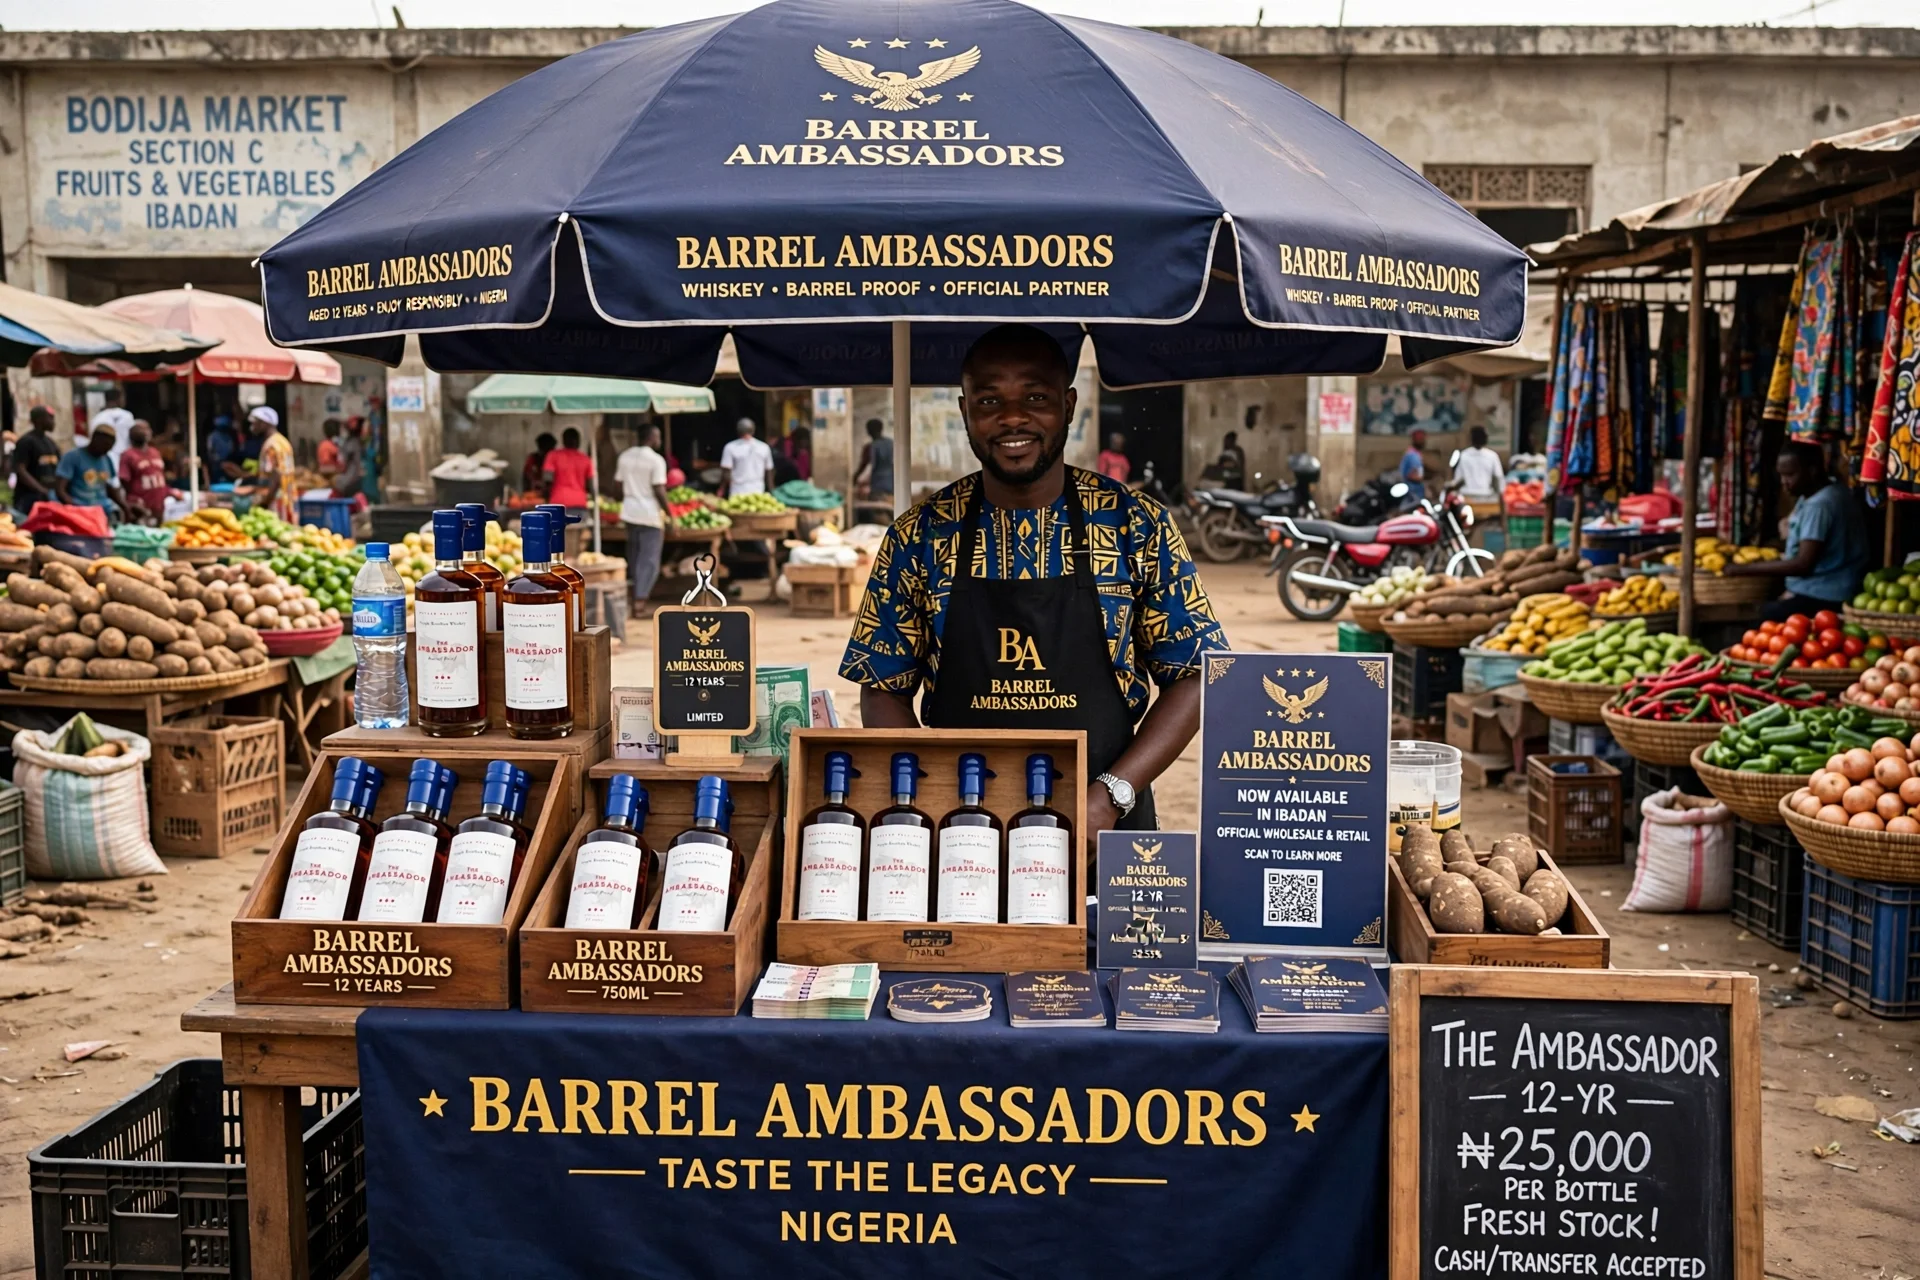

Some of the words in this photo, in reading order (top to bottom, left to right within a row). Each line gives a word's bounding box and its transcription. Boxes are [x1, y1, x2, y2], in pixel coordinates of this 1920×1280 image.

[66, 95, 191, 133] BODIJA
[204, 95, 347, 133] MARKET
[805, 119, 989, 140] BARREL
[129, 139, 234, 164] SECTION
[248, 140, 263, 164] C
[724, 144, 1064, 166] AMBASSADORS
[56, 170, 142, 196] FRUITS
[152, 171, 168, 196] &
[178, 170, 335, 196] VEGETABLES
[147, 203, 237, 228] IBADAN
[676, 236, 825, 270] BARREL
[835, 234, 1114, 269] AMBASSADORS
[307, 262, 375, 298] BARREL
[378, 244, 512, 289] AMBASSADORS
[1279, 243, 1352, 281] BARREL
[1356, 253, 1480, 297] AMBASSADORS
[682, 282, 764, 298] WHISKEY
[786, 281, 856, 297] BARREL
[861, 281, 921, 296] PROOF
[943, 281, 1023, 296] OFFICIAL
[1029, 281, 1109, 296] PARTNER
[308, 308, 330, 321] AGED
[332, 307, 340, 319] 12
[343, 304, 367, 318] YEARS
[377, 300, 401, 314] ENJOY
[1286, 288, 1323, 304] WHISKEY
[1333, 293, 1368, 309] BARREL
[1370, 297, 1398, 312] PROOF
[1407, 301, 1441, 317] OFFICIAL
[682, 649, 727, 660] BARREL
[997, 627, 1046, 671] BA
[665, 661, 745, 672] AMBASSADORS
[685, 677, 695, 687] 12
[697, 676, 725, 687] YEARS
[991, 679, 1055, 693] BARREL
[970, 694, 1077, 710] AMBASSADORS
[686, 713, 724, 722] LIMITED
[1253, 730, 1336, 750] BARREL
[1217, 751, 1371, 773] AMBASSADORS
[1237, 789, 1270, 803] NOW
[1274, 790, 1348, 805] AVAILABLE
[1257, 808, 1271, 821] IN
[1275, 809, 1327, 822] IBADAN
[1217, 827, 1261, 839] OFFICIAL
[1263, 828, 1323, 841] WHOLESALE
[1325, 830, 1333, 841] &
[1336, 830, 1370, 842] RETAIL
[1244, 849, 1269, 860] SCAN
[1271, 850, 1284, 860] TO
[1286, 850, 1315, 861] LEARN
[1316, 851, 1343, 862] MORE
[1126, 865, 1169, 875] BARREL
[1109, 876, 1188, 887] AMBASSADORS
[1131, 889, 1163, 902] 12-YR
[313, 929, 419, 953] BARREL
[575, 939, 673, 962] BARREL
[283, 954, 453, 977] AMBASSADORS
[548, 962, 703, 983] AMBASSADORS
[334, 979, 350, 992] 12
[355, 979, 403, 993] YEARS
[602, 986, 649, 1000] 750ML
[1431, 1020, 1497, 1068] THE
[1511, 1022, 1720, 1078] AMBASSADOR
[1521, 1081, 1617, 1115] 12-YR
[469, 1076, 736, 1137] BARREL
[756, 1083, 1268, 1147] AMBASSADORS
[1457, 1126, 1651, 1177] ₦25,000
[659, 1157, 792, 1191] TASTE
[807, 1159, 887, 1193] THE
[906, 1162, 1076, 1197] LEGACY
[1504, 1177, 1545, 1200] PER
[1555, 1179, 1638, 1202] BOTTLE
[780, 1211, 957, 1245] NIGERIA
[1463, 1203, 1545, 1236] FRESH
[1434, 1245, 1598, 1276] CASH/TRANSFER
[1607, 1252, 1706, 1279] ACCEPTED
